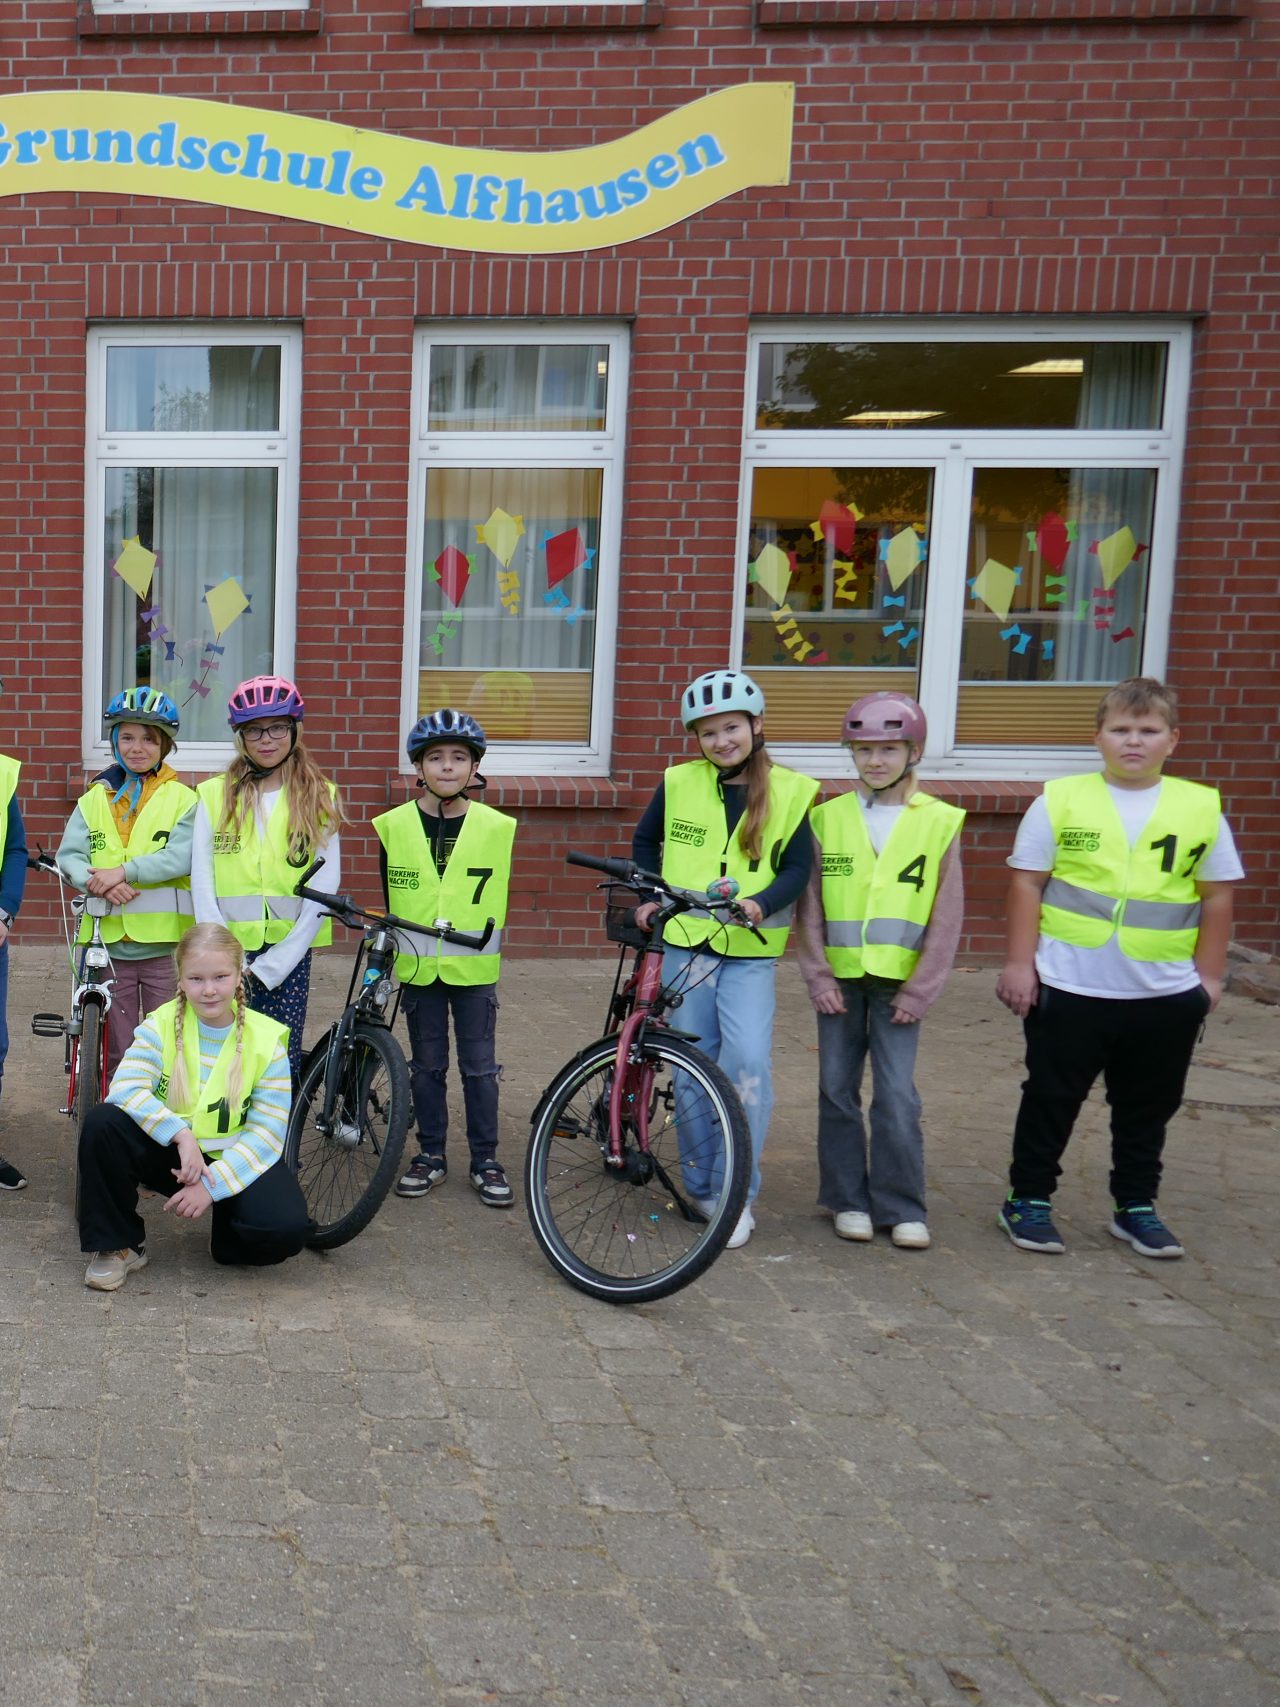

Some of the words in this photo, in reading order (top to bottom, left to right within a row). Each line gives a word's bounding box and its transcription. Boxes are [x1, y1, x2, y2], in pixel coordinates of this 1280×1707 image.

[395, 132, 727, 225] Alfhausen
[822, 857, 854, 865] ERKEHRS
[897, 854, 927, 894] 4
[1150, 834, 1208, 878] 11
[466, 867, 494, 905] 7
